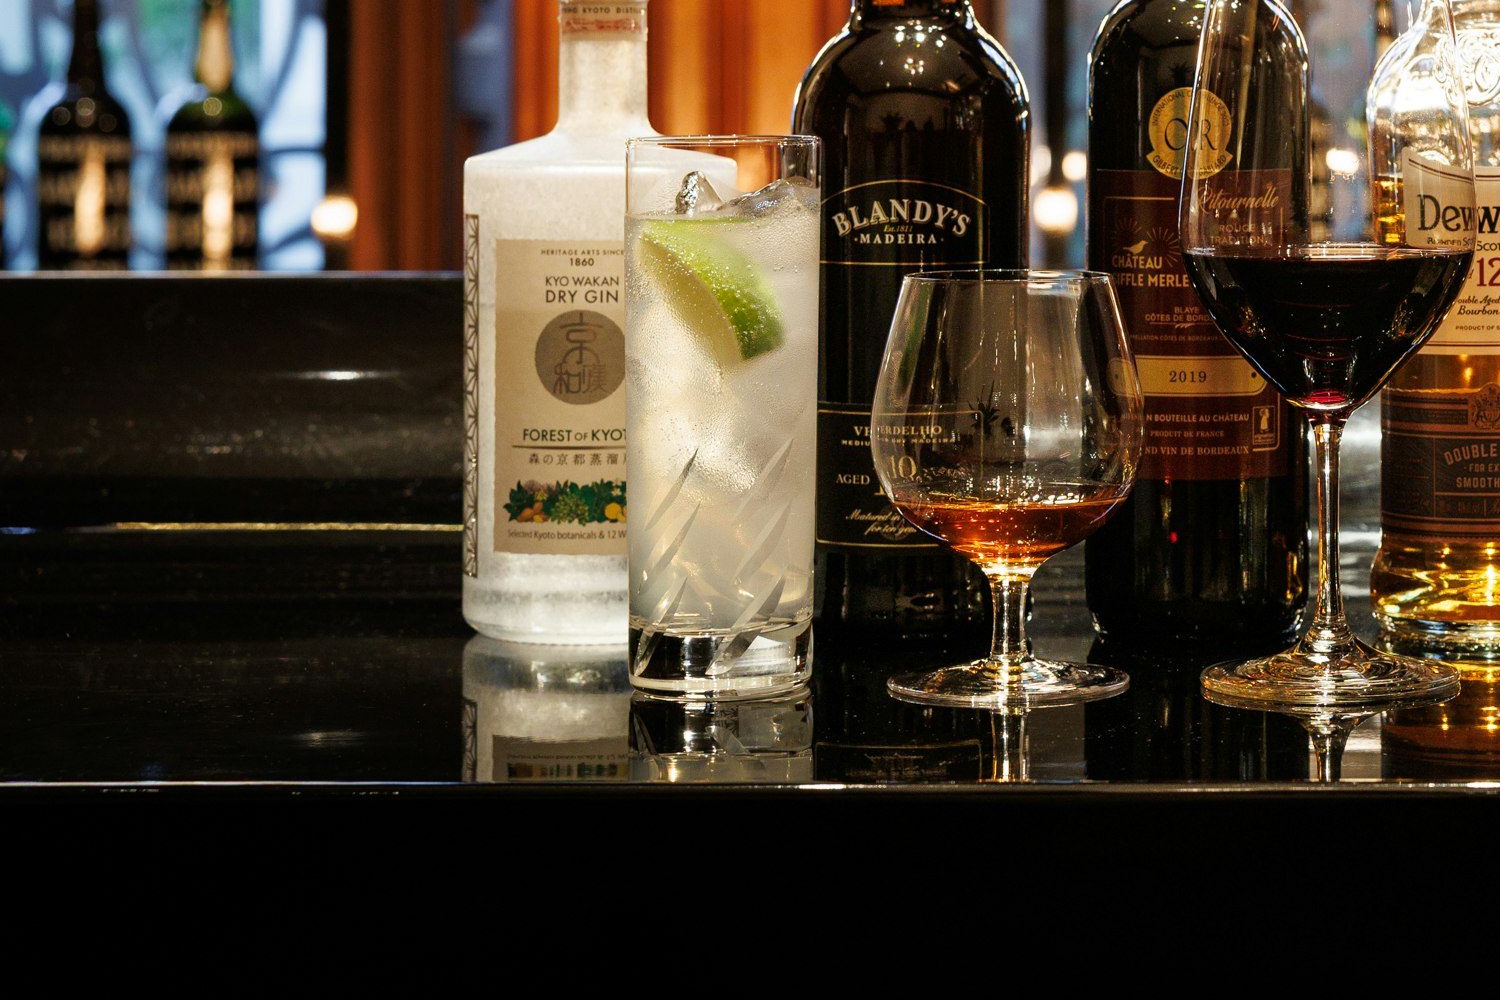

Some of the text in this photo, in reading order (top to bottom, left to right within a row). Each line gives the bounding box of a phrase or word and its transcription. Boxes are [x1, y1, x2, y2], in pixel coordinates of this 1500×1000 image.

[1152, 154, 1178, 176] GILBERT
[832, 198, 972, 237] BLANDY'S
[1219, 223, 1256, 233] ROUGE
[860, 233, 937, 245] MADEIRA
[569, 257, 595, 267] 1860
[1111, 252, 1163, 270] CHÂTEAU
[545, 275, 620, 287] KYO WAKAN
[1148, 273, 1190, 288] MERLE
[545, 289, 619, 304] DRY GIN
[1457, 294, 1479, 305] ouble
[1480, 295, 1500, 307] Aged
[1174, 306, 1200, 314] BLAYE
[1457, 305, 1499, 316] Bourbon
[1145, 313, 1213, 322] CÔTES DE BORD
[1169, 370, 1207, 383] 2019
[1154, 414, 1197, 422] BOUTEILLE
[1198, 414, 1211, 422] AU
[1212, 411, 1250, 422] CHÂTEAU
[522, 428, 627, 442] FOREST OF KYOT
[1160, 446, 1178, 455] VIN
[1180, 446, 1194, 455] DE
[1197, 445, 1250, 455] BORDEAUX
[1443, 442, 1498, 465] DOUBLE
[528, 453, 627, 466] 森の京都蒸溜
[1469, 463, 1485, 473] FOR
[835, 474, 871, 485] AGED
[846, 509, 892, 522] Matured
[533, 530, 556, 541] Kyoto
[557, 530, 597, 540] botanicals
[598, 531, 605, 539] &
[607, 530, 617, 539] 12
[864, 523, 881, 536] for
[881, 524, 897, 533] ten
